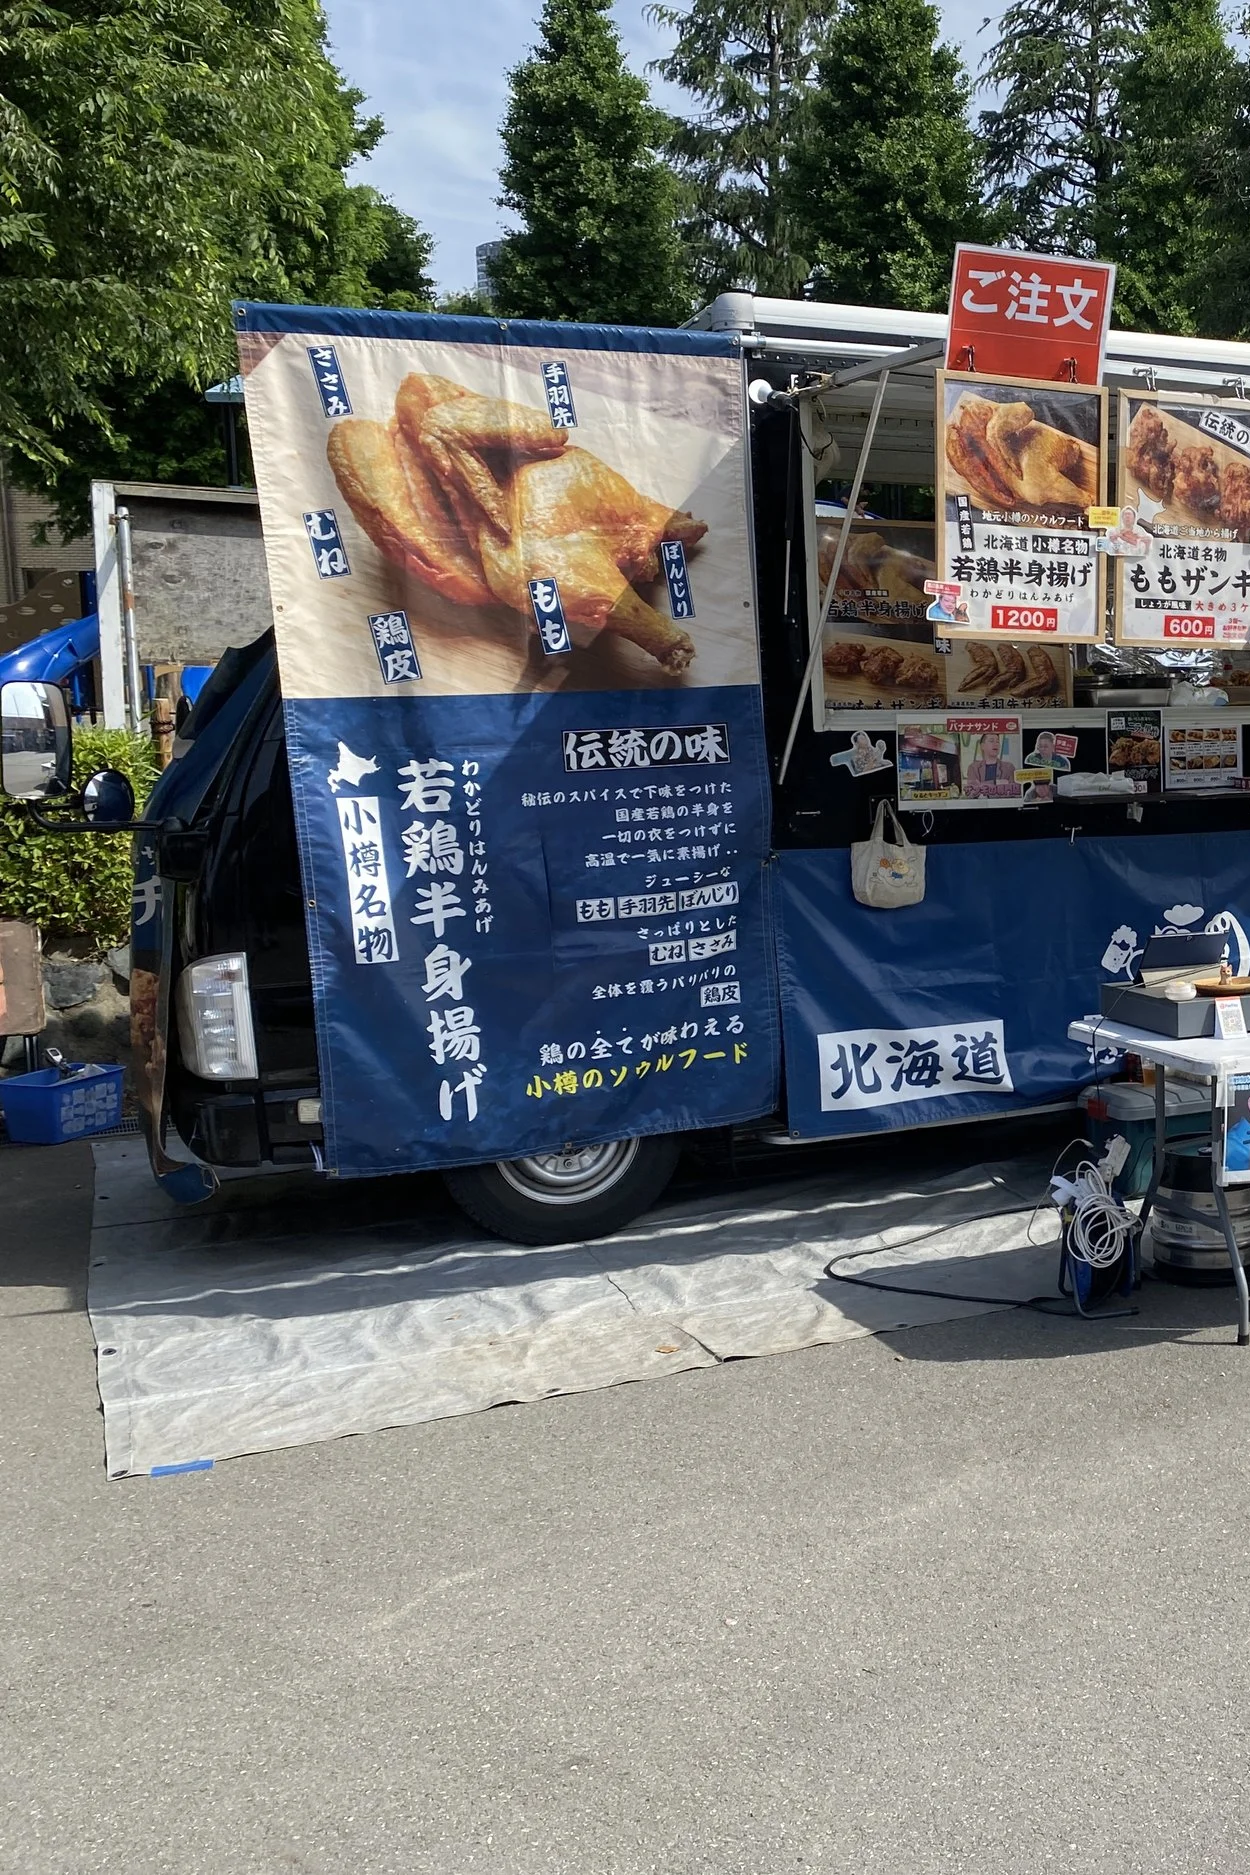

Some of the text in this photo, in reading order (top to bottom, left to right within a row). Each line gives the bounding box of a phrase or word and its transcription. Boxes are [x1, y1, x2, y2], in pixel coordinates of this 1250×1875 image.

[962, 269, 1098, 331] ご注文
[311, 347, 350, 416] ささみ
[544, 363, 575, 427] 手羽先
[957, 496, 974, 550] 国産若鶏
[982, 510, 1084, 528] 地元小樽のソウルフード
[1152, 524, 1239, 540] 北海道ご当地から揚げ
[306, 513, 349, 576] むね
[984, 534, 1089, 555] 北海道 小樽名物
[1160, 544, 1228, 562] 北海道名物
[664, 544, 692, 617] ぼんじり
[951, 555, 1093, 588] 若鶏半身揚げ
[970, 588, 1075, 603] わかどりはんみあげ
[1140, 599, 1187, 610] しょうが風味
[531, 580, 567, 652] もも
[995, 609, 1056, 628] 1200円
[1169, 618, 1213, 636] 600円
[372, 614, 418, 682] 鶏皮
[949, 722, 998, 732] バナナサンド
[565, 726, 729, 770] 伝統の味
[521, 782, 733, 806] 秘伝のスパイスで下味をつけた
[615, 802, 733, 822] 国産若鶏の半身を
[462, 760, 494, 934] わかどりはんみあげ
[602, 822, 737, 844] 一切の衣をつけずに
[343, 800, 394, 963] 小樽名物
[645, 866, 731, 888] ジューシーな
[578, 884, 738, 919] もも 手羽先 ぼんじり
[397, 758, 488, 1122] 若鶏半身揚げ
[637, 915, 737, 940] さっぱりとした
[651, 932, 734, 963] むね ささみ
[592, 964, 736, 1000] 全体を覆うパリパリの
[704, 984, 739, 1004] 鶏皮
[539, 1015, 745, 1067] 鶏の全てが味わえる
[829, 1031, 1006, 1100] 北海道
